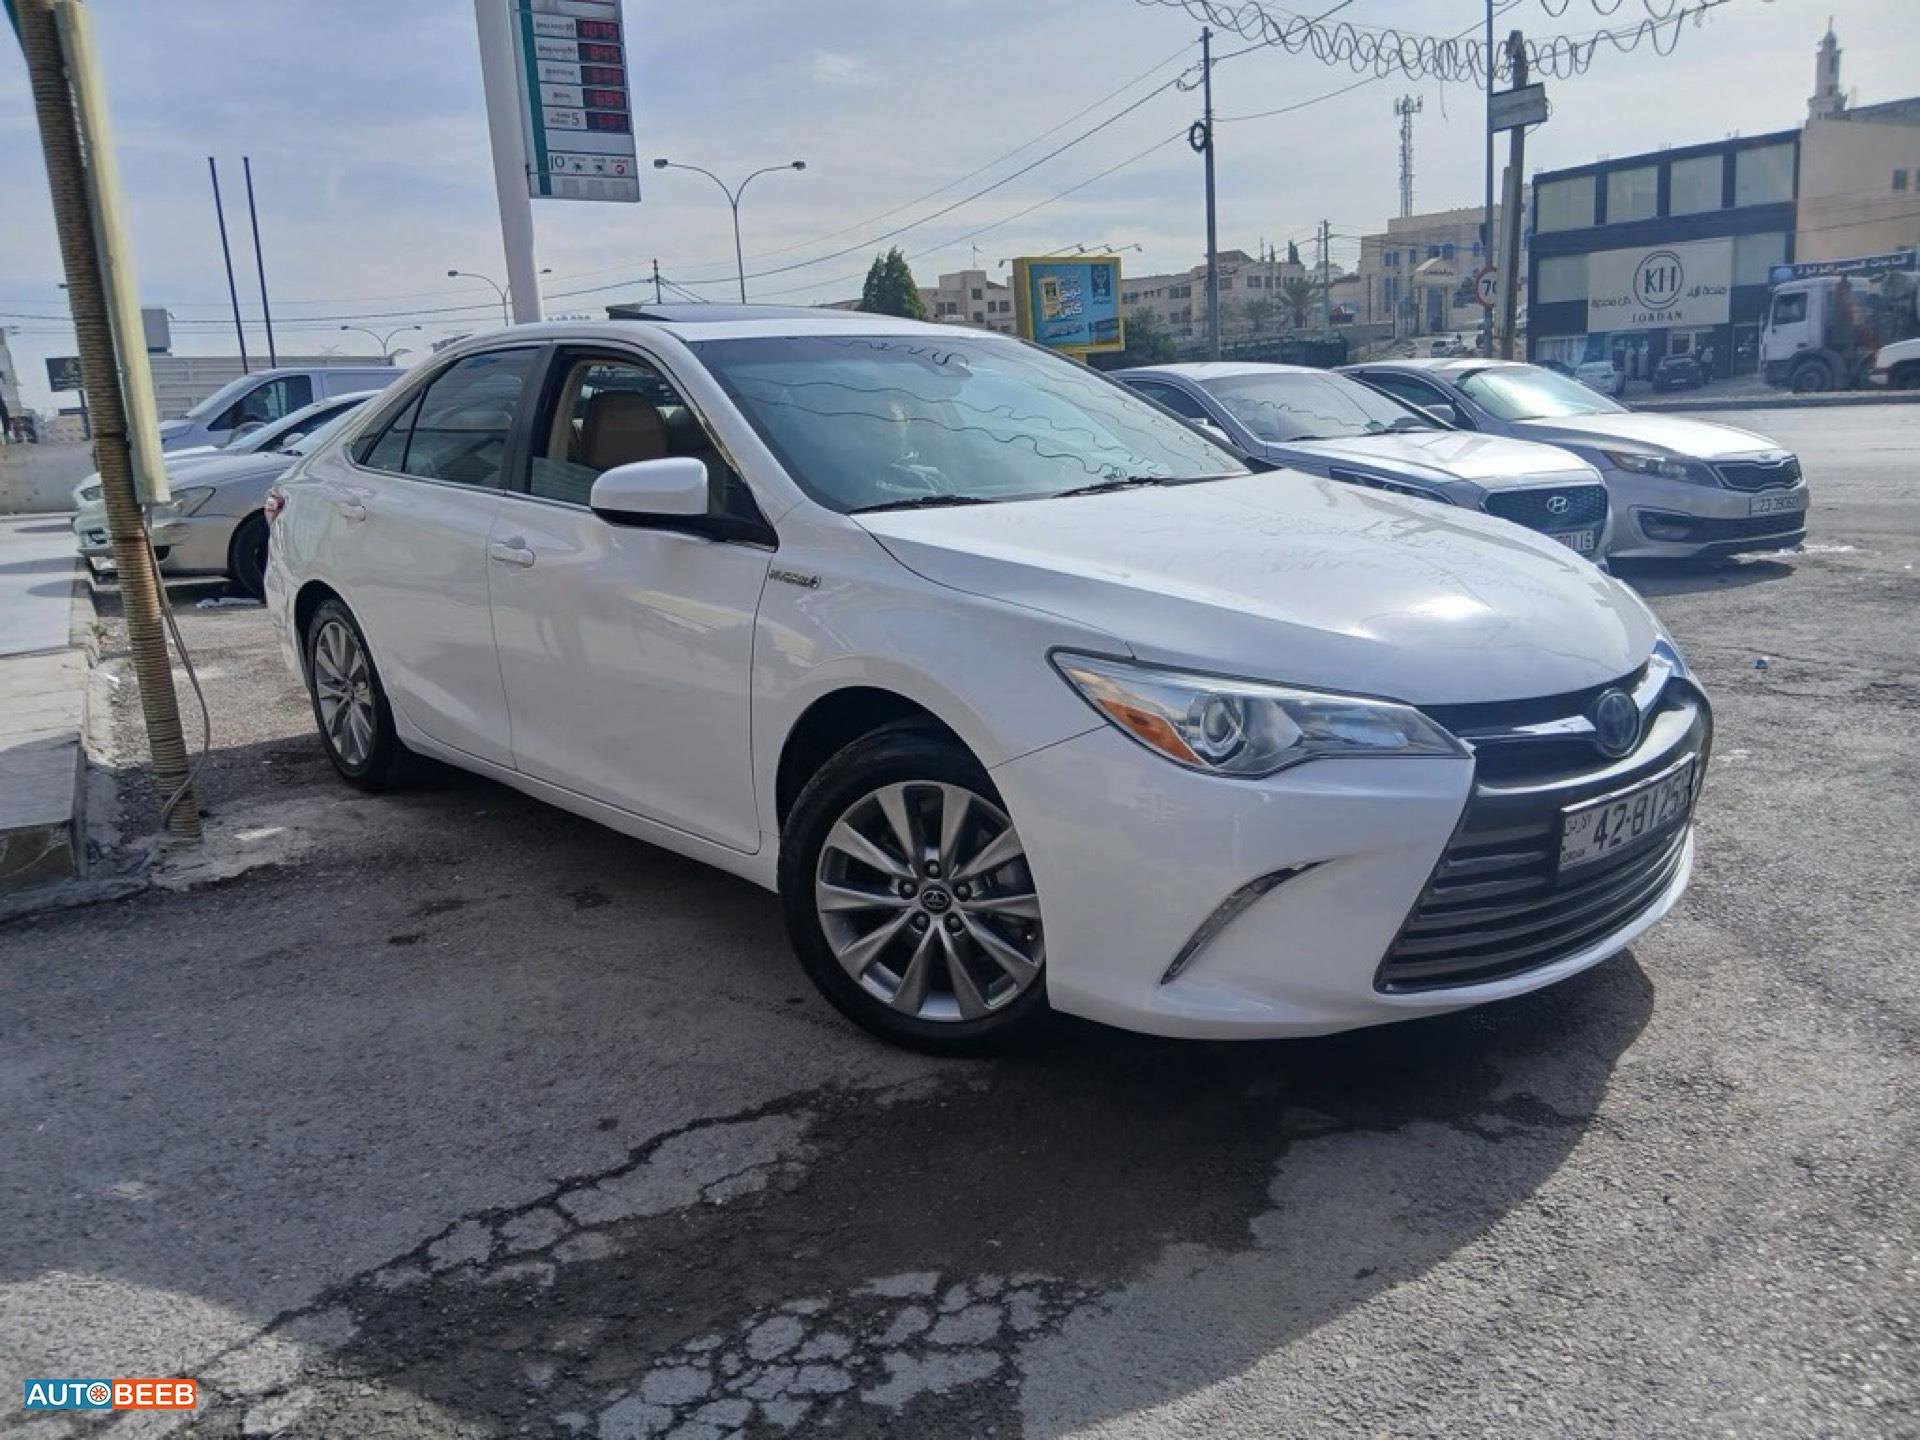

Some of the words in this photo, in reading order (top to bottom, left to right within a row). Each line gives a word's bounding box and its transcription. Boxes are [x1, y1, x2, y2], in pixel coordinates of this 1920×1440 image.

[571, 112, 580, 126] 5
[1644, 266, 1677, 294] KH
[1632, 311, 1683, 324] JORDAN
